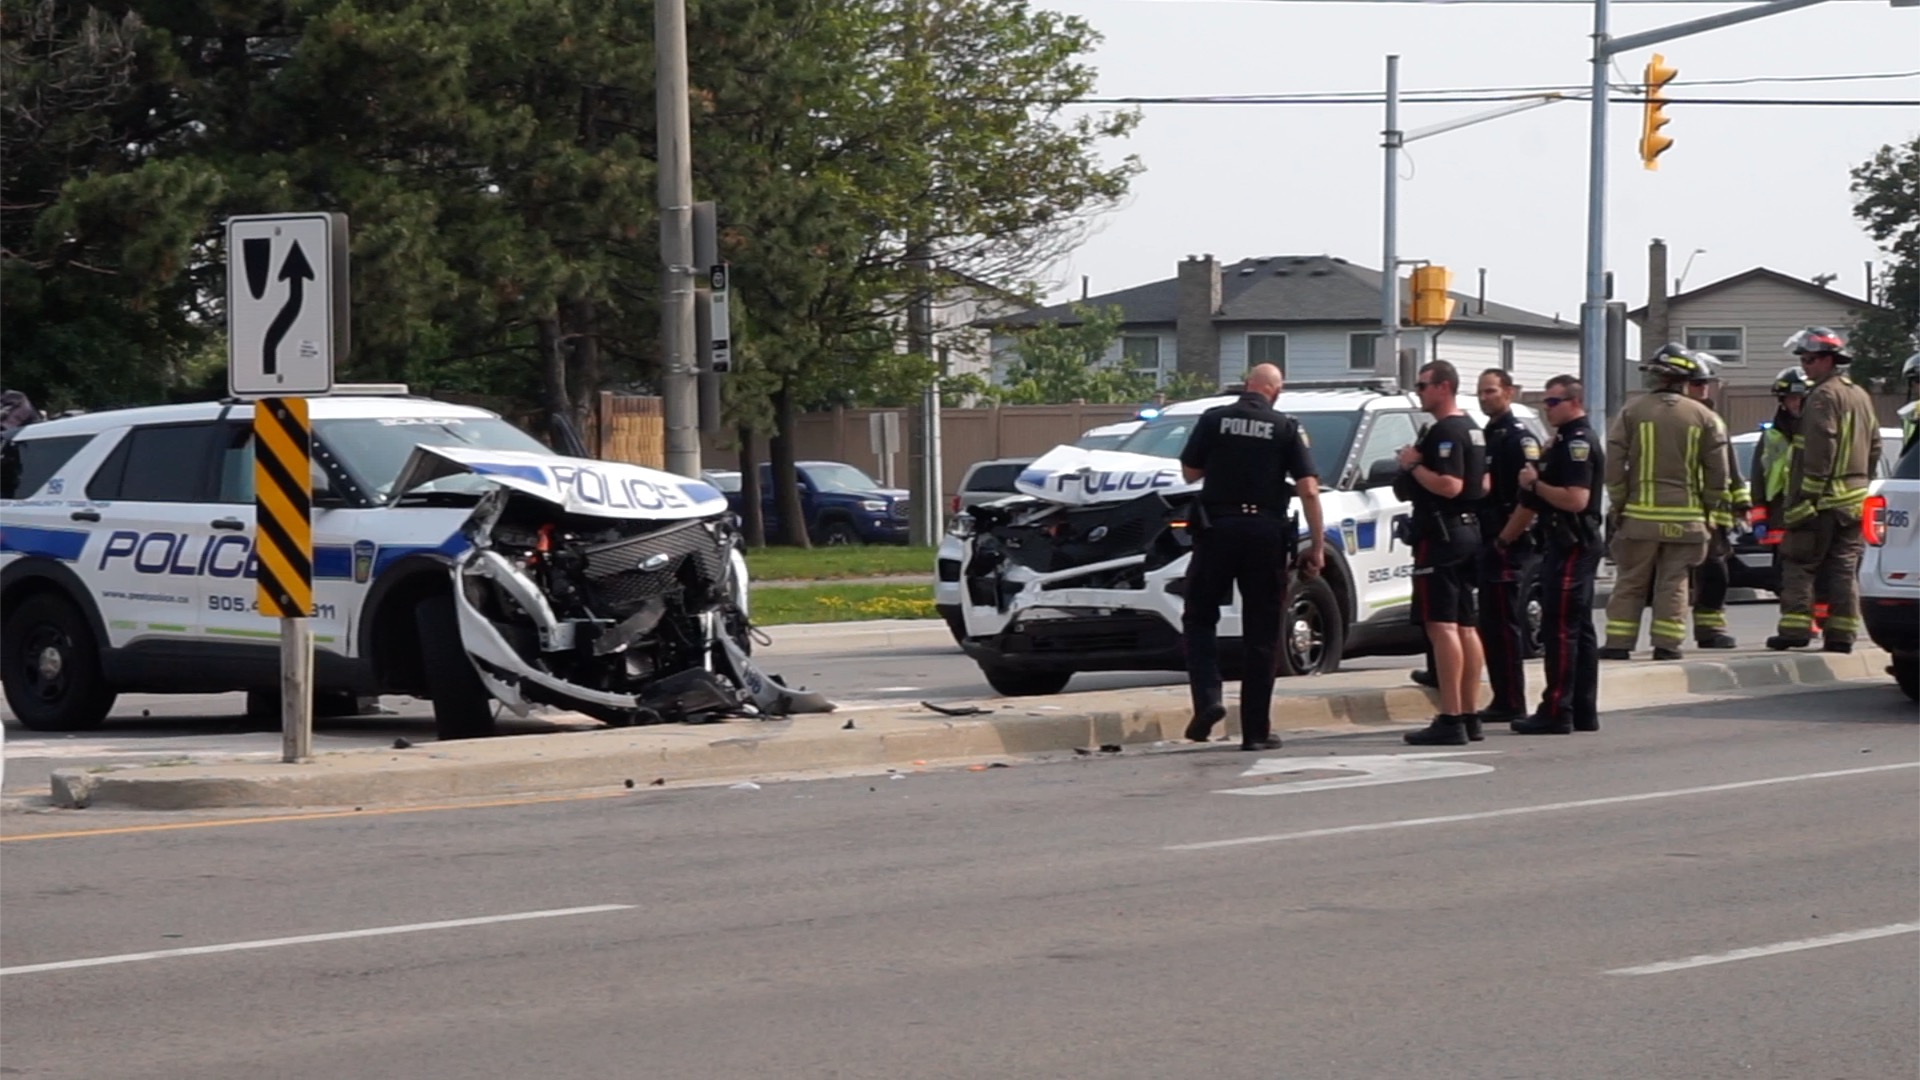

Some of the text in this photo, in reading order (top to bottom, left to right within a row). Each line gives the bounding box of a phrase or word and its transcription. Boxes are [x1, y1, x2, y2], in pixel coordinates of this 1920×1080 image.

[1220, 417, 1274, 440] POLICE
[548, 465, 688, 510] POLICE
[1887, 509, 1909, 528] 286
